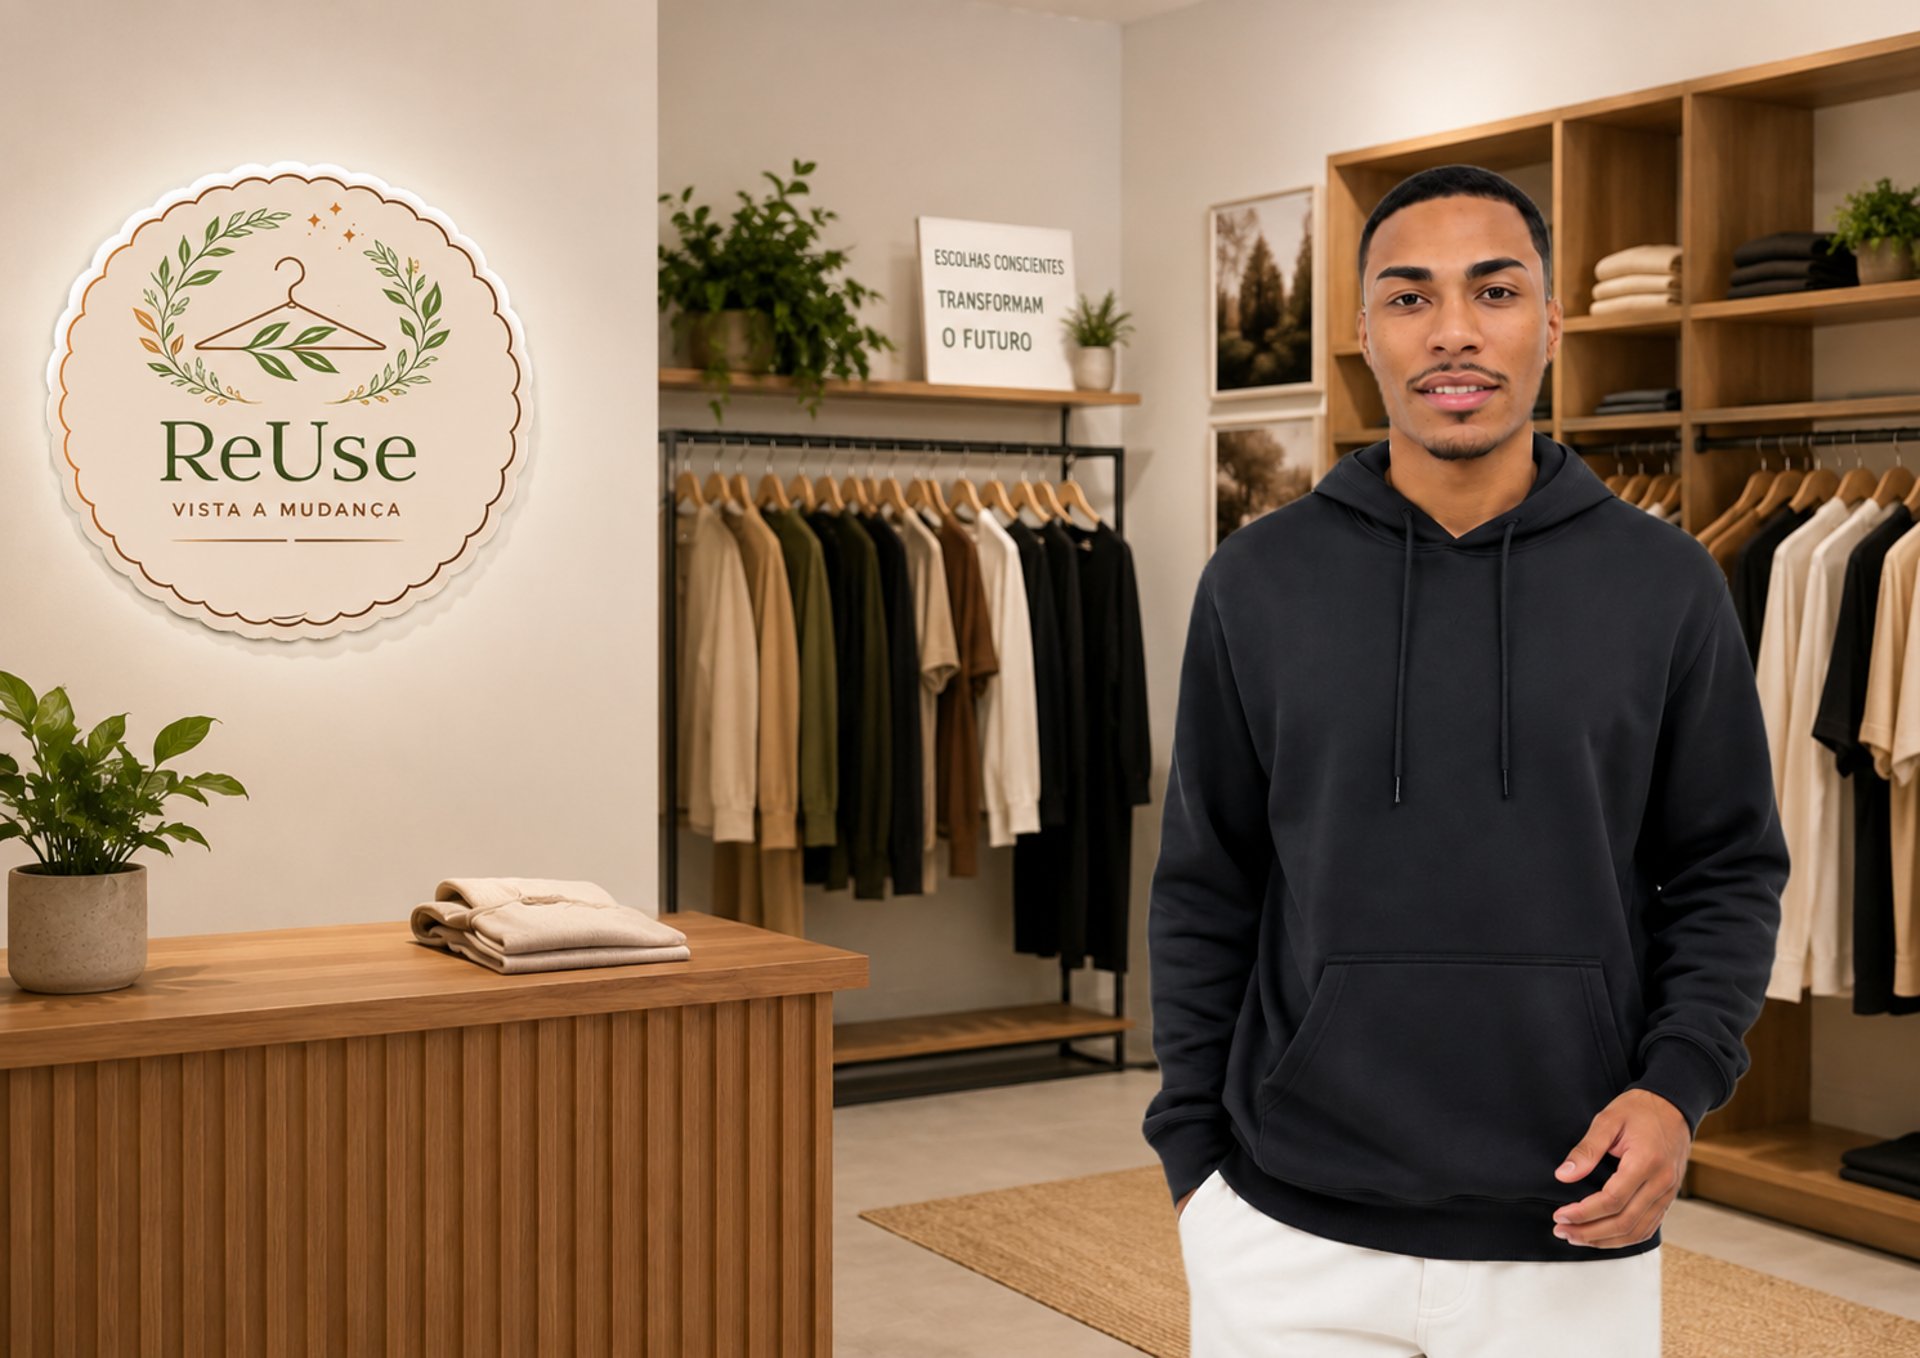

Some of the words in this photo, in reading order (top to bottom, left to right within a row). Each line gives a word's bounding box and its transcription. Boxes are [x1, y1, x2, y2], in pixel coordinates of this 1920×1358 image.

[934, 249, 991, 269] ESCOLHAS
[994, 254, 1065, 275] CONSCIENTES
[938, 290, 1043, 313] TRANSFORMAM
[942, 327, 956, 348] O
[963, 328, 1032, 351] FUTURO
[161, 421, 416, 481] ReUse
[172, 502, 241, 517] VISTA
[253, 502, 267, 517] A
[280, 502, 401, 519] MUDANÇA
